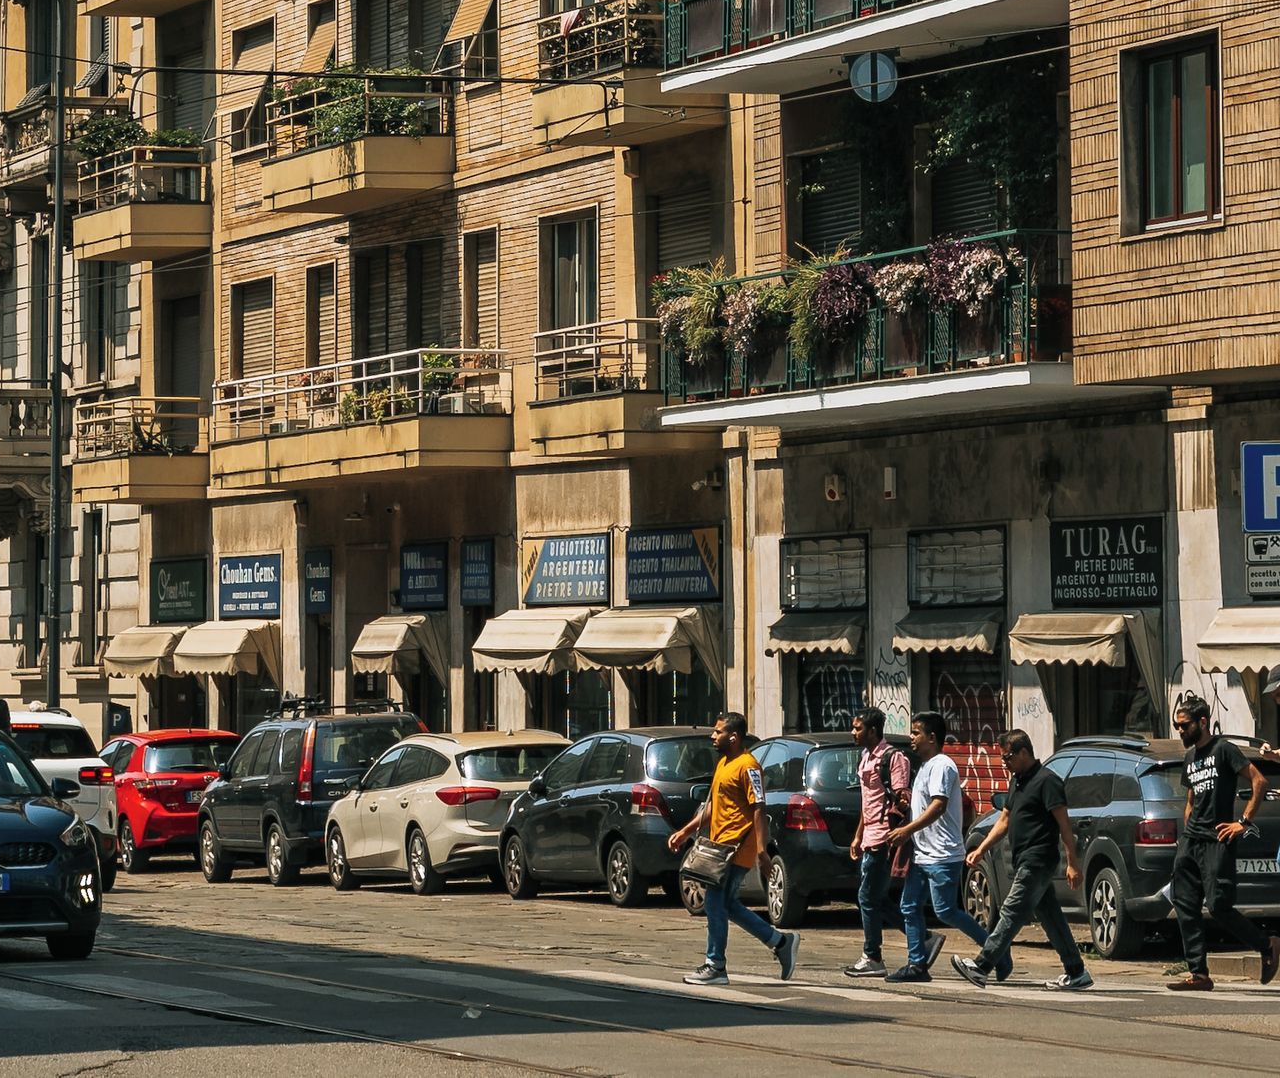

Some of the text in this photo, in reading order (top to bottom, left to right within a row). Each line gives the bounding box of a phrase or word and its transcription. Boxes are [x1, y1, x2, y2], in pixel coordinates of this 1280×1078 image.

[549, 537, 607, 557] BIGIOTTERIA
[628, 533, 693, 552] ARGENTO INDIANO
[1062, 524, 1147, 557] TURAG
[542, 559, 607, 577] ARGENTERIA
[628, 555, 702, 573] ARGENTO THAILANDIA
[1075, 558, 1135, 572] PIETRE DURE
[221, 563, 253, 584] Chouhan
[1056, 574, 1097, 585] ARGENTO
[1108, 573, 1156, 584] MINUTERIA
[1250, 569, 1276, 578] eccetto
[310, 586, 326, 602] Gems
[535, 580, 606, 599] PIETRE DURE
[628, 576, 708, 595] ARGENTO MINUTERIA
[1054, 586, 1158, 599] INGROSSO-DETTAGLIO
